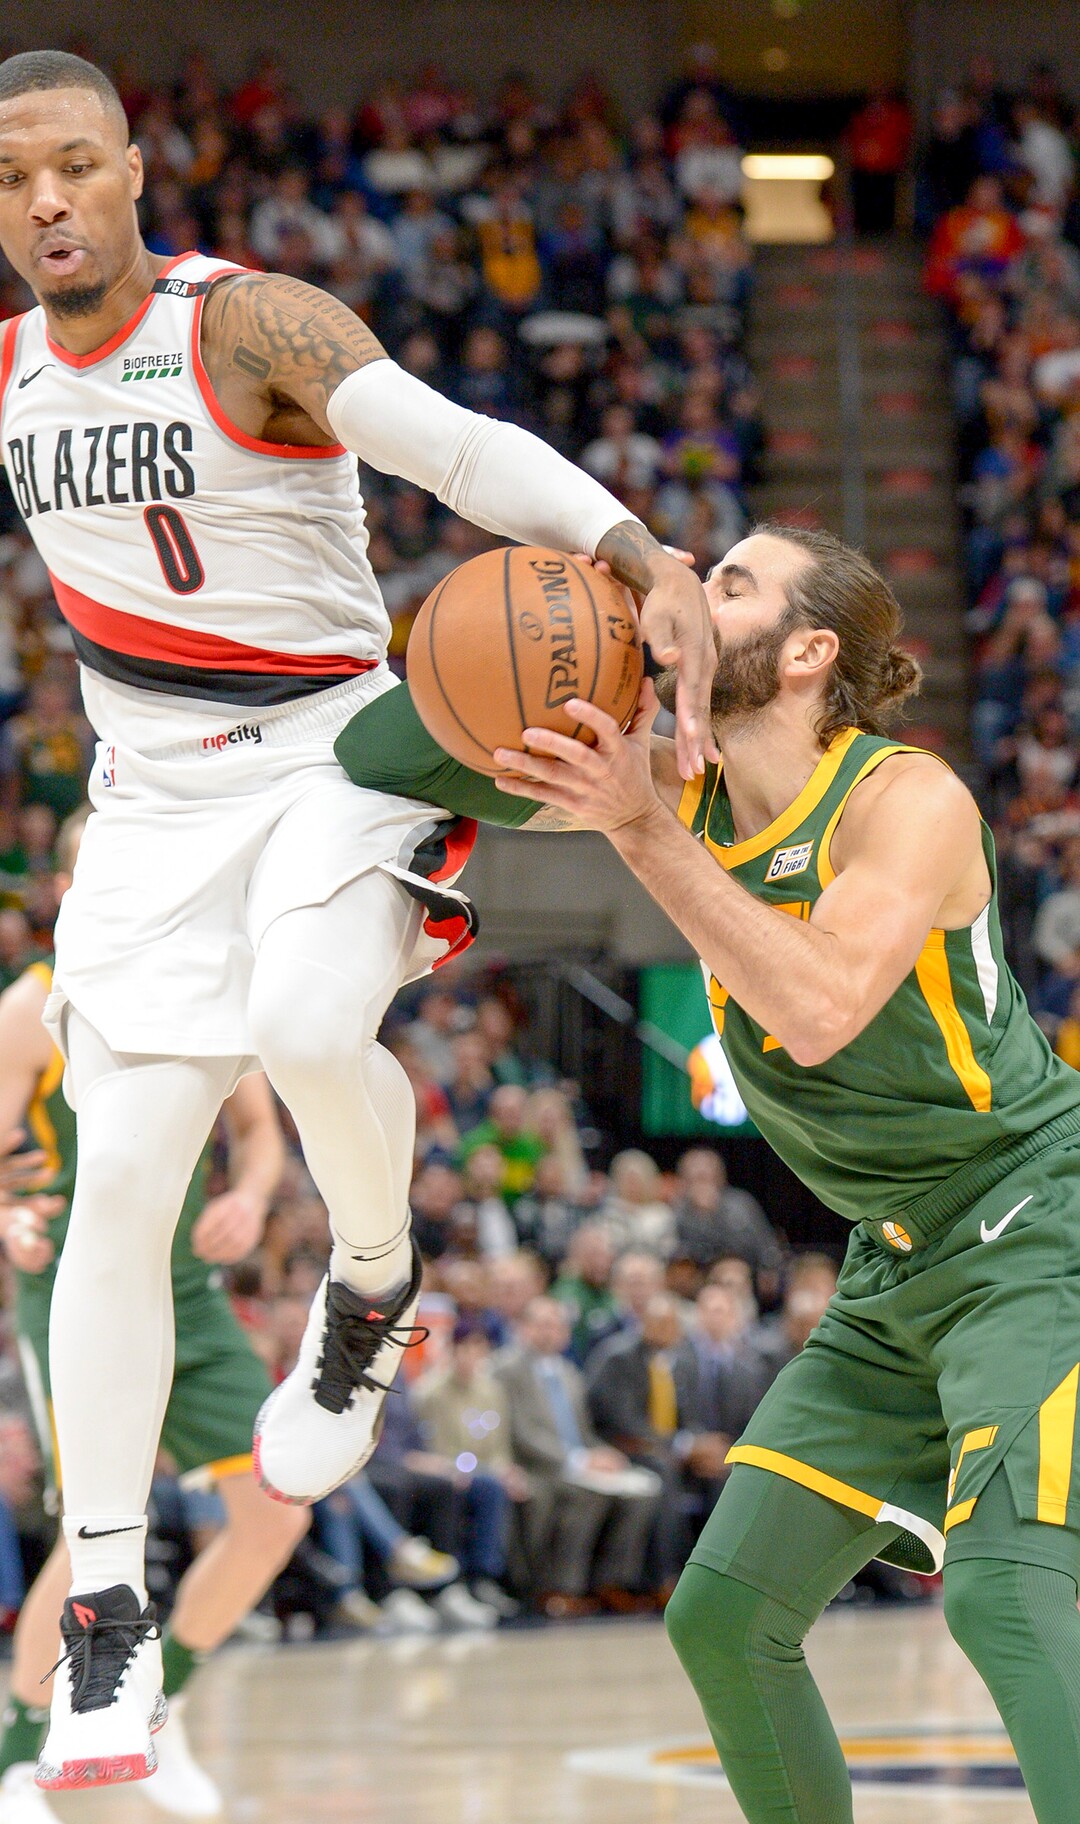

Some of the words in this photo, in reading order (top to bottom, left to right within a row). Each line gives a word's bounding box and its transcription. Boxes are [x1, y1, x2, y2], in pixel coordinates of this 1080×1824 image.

[164, 280, 189, 297] PGA
[8, 421, 196, 519] BLAZERS
[143, 504, 206, 596] 0
[771, 852, 786, 877] 5
[783, 856, 808, 874] FIGHT
